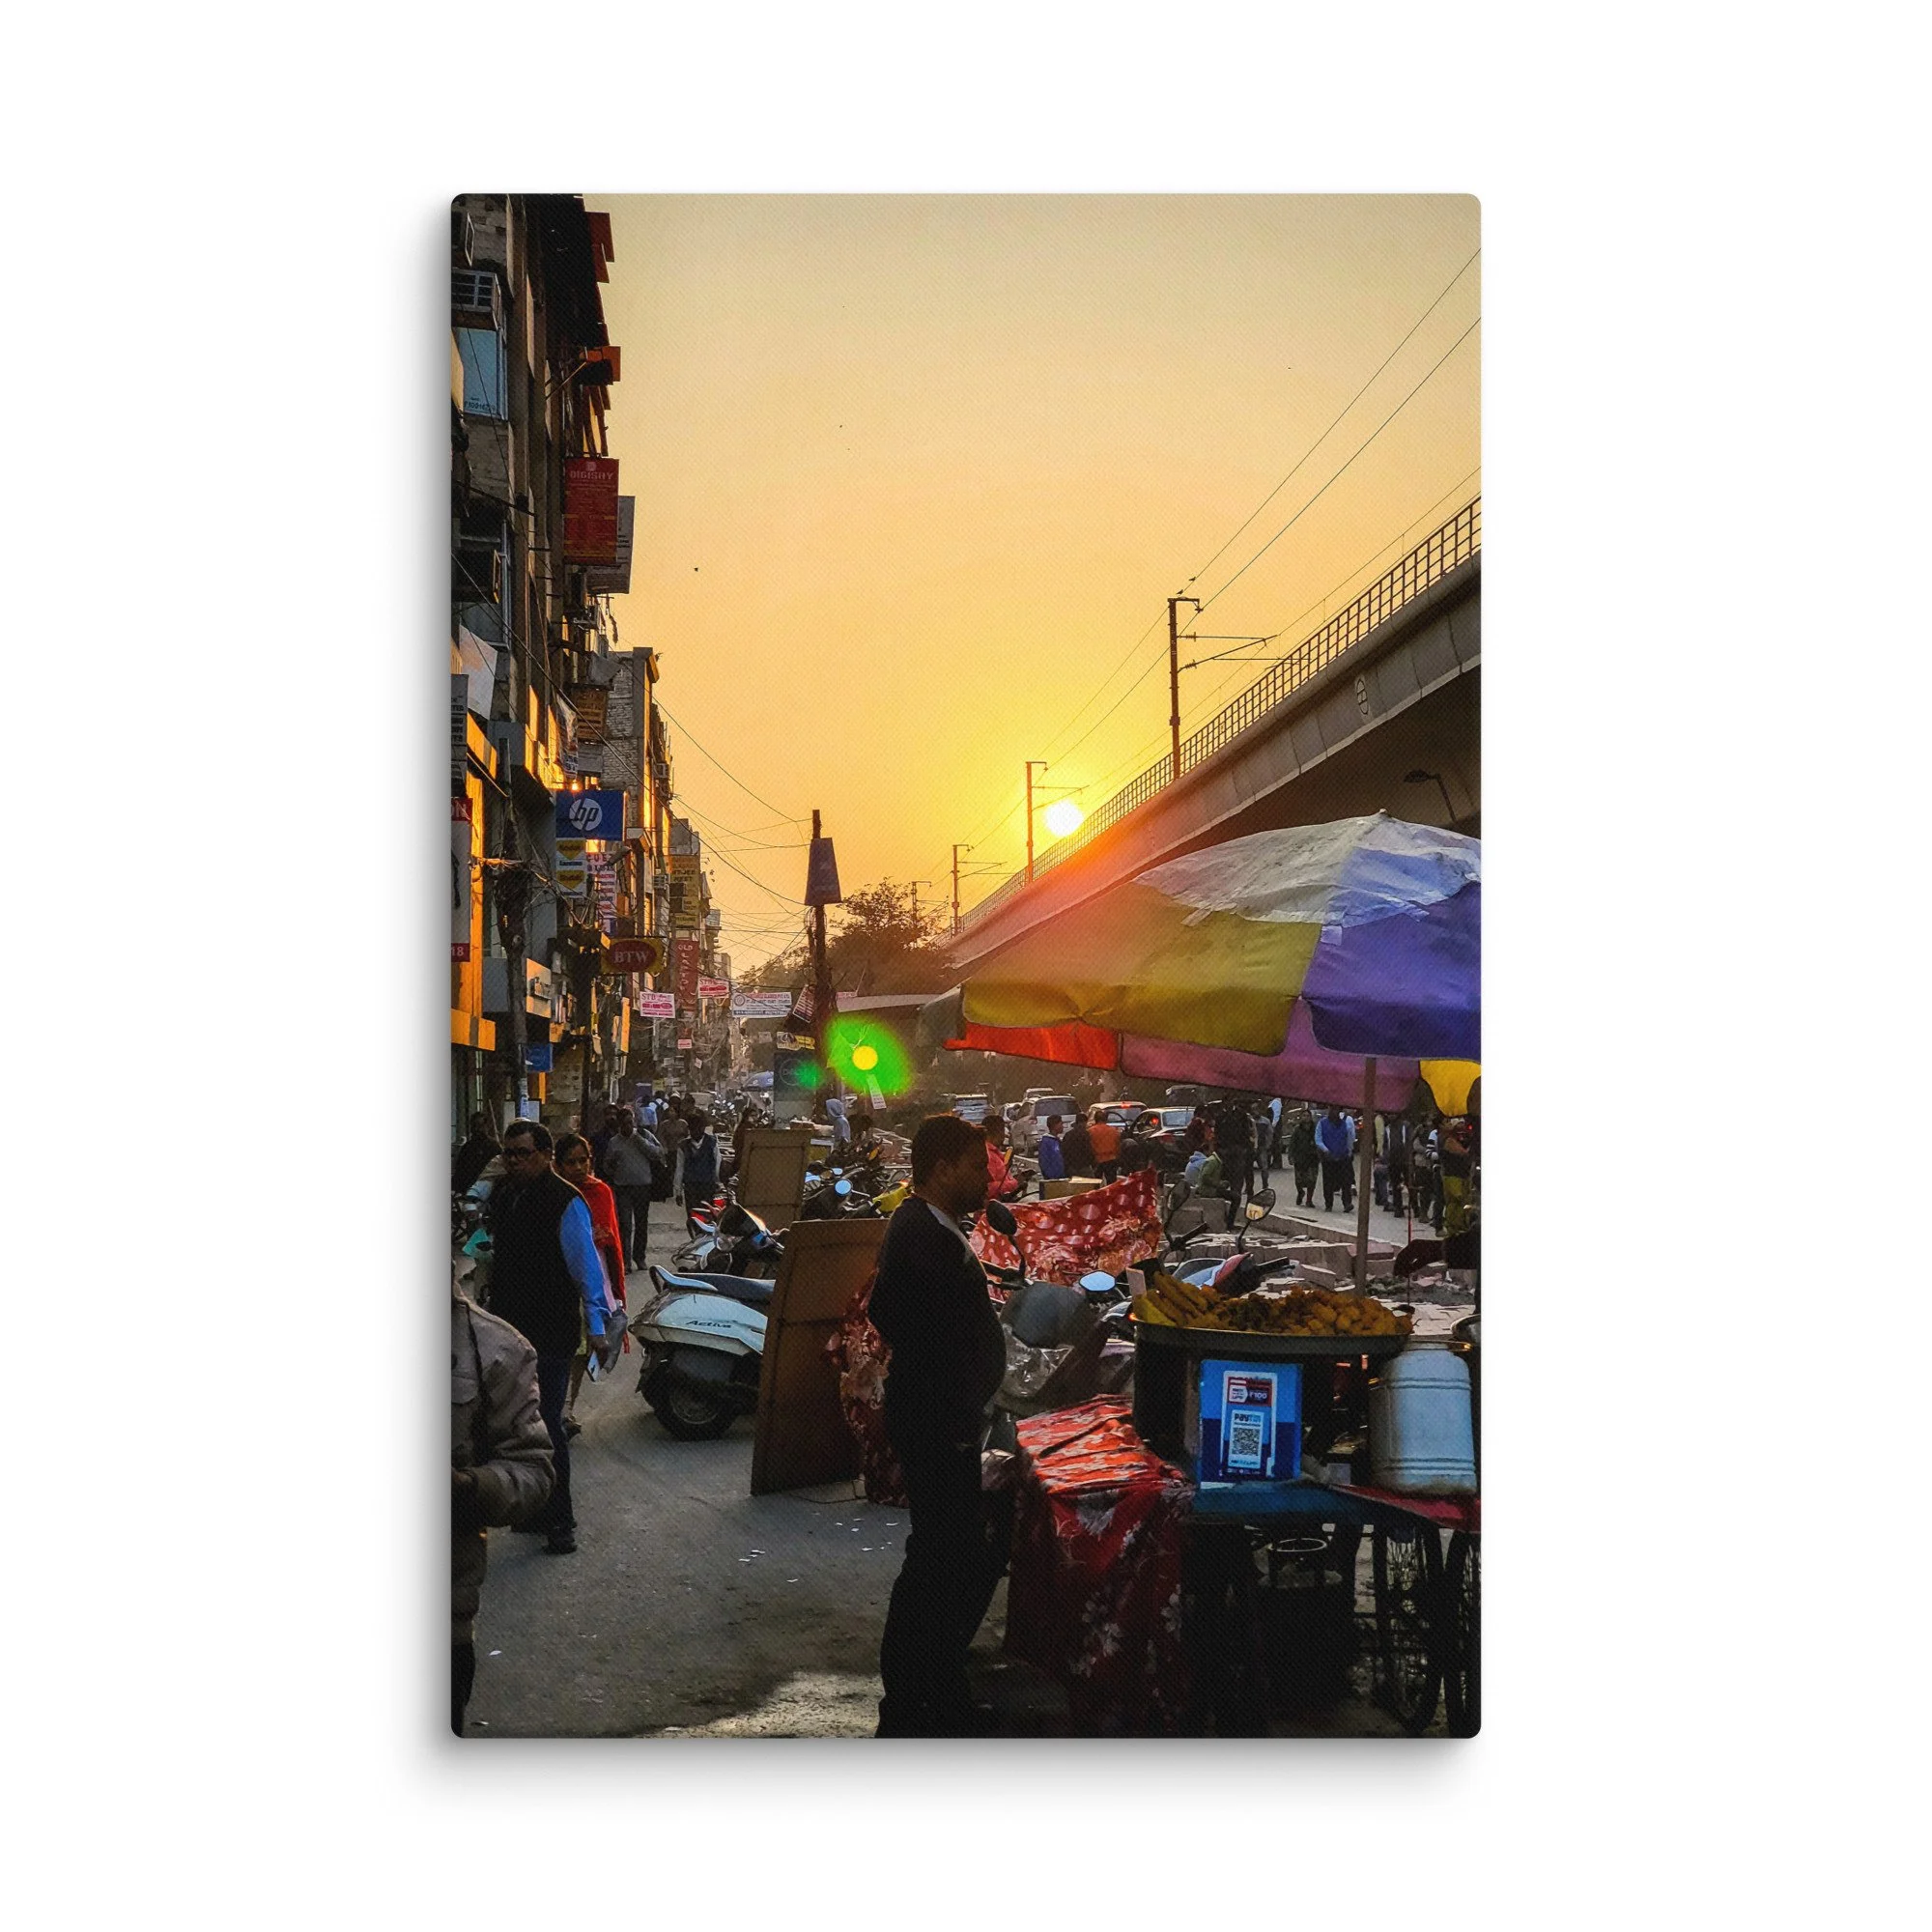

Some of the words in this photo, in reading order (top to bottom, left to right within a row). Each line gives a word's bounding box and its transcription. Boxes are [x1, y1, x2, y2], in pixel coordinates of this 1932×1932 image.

[570, 798, 602, 831] hp
[613, 951, 650, 964] BTW
[685, 1320, 732, 1329] Activa
